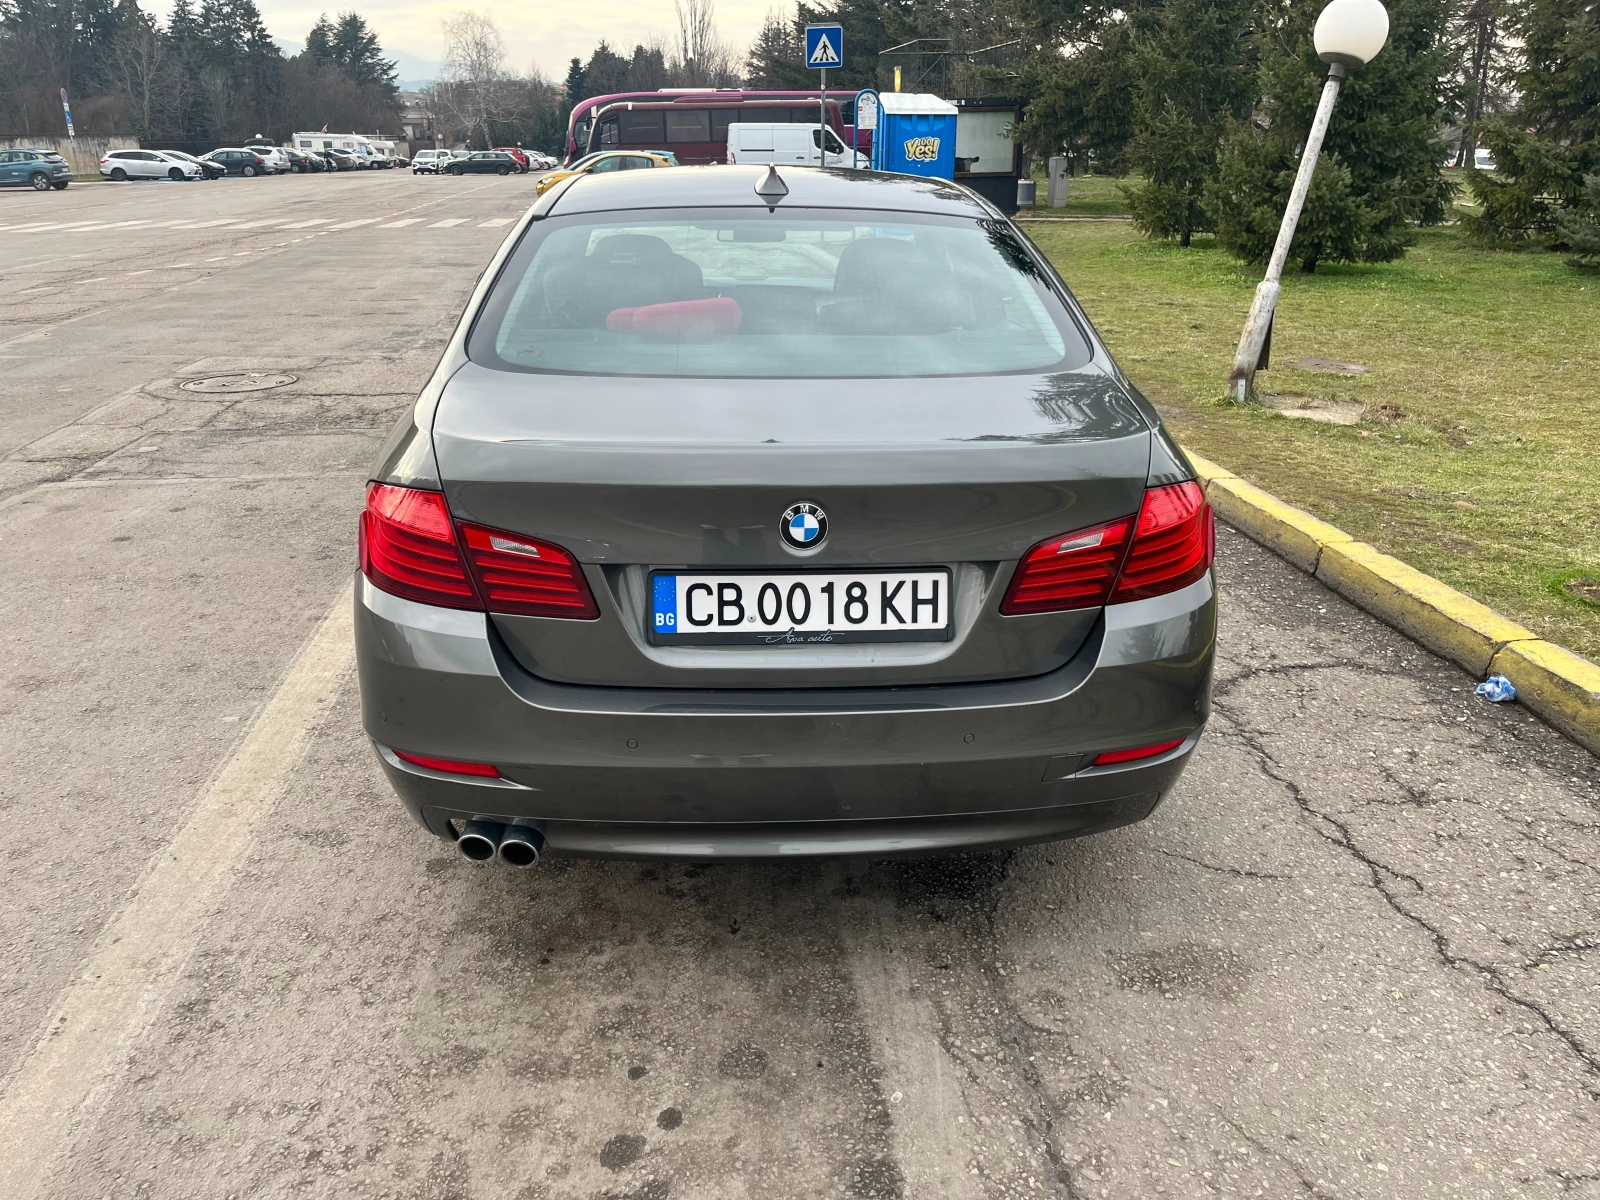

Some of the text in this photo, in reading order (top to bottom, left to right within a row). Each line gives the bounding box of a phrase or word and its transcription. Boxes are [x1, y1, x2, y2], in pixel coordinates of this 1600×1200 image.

[905, 138, 939, 160] Yes!
[784, 504, 825, 521] BMW
[685, 579, 939, 627] CB 0018 KH
[655, 612, 675, 626] BG
[808, 630, 844, 642] auto
